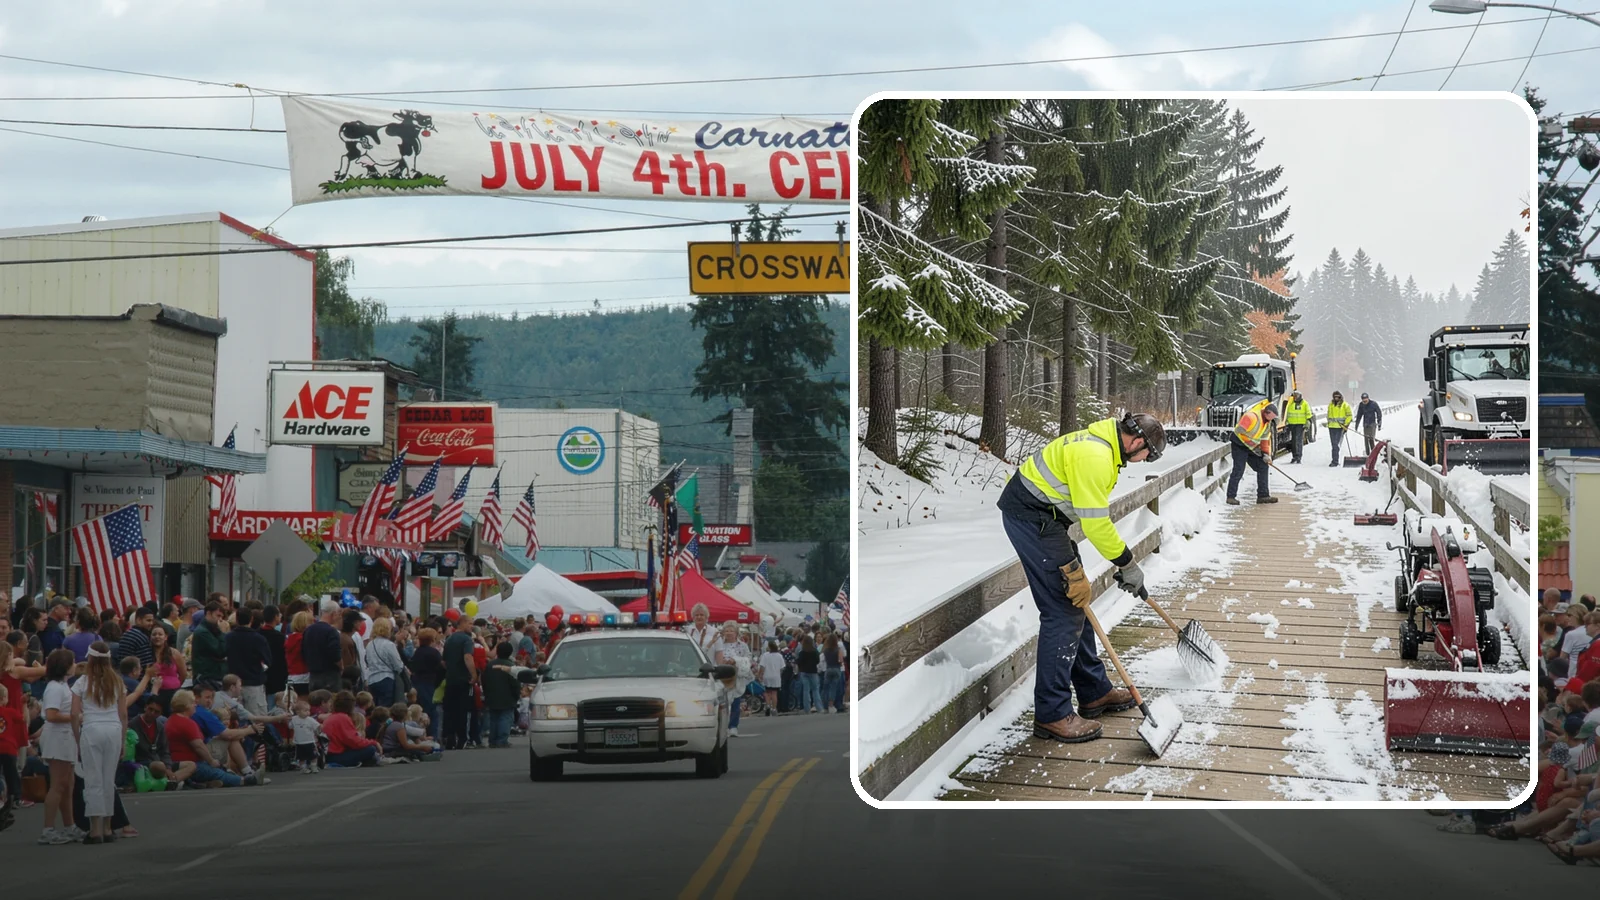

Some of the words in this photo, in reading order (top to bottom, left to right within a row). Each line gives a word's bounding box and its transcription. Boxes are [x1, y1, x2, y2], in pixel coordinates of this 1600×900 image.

[481, 141, 604, 192] JULY
[632, 150, 746, 198] 4th.
[697, 254, 850, 280] CROSSWA
[283, 380, 373, 420] ACE
[406, 409, 453, 422] CEDAR
[461, 409, 485, 422] LOG
[283, 421, 371, 436] Hardware
[416, 428, 477, 447] Coca-Cola
[83, 485, 93, 494] St.
[96, 485, 124, 494] Vincent
[126, 486, 136, 495] de
[137, 486, 155, 495] Paul
[212, 516, 331, 535] HARDARE
[688, 526, 741, 535] CRNATION
[699, 535, 730, 543] GLASS
